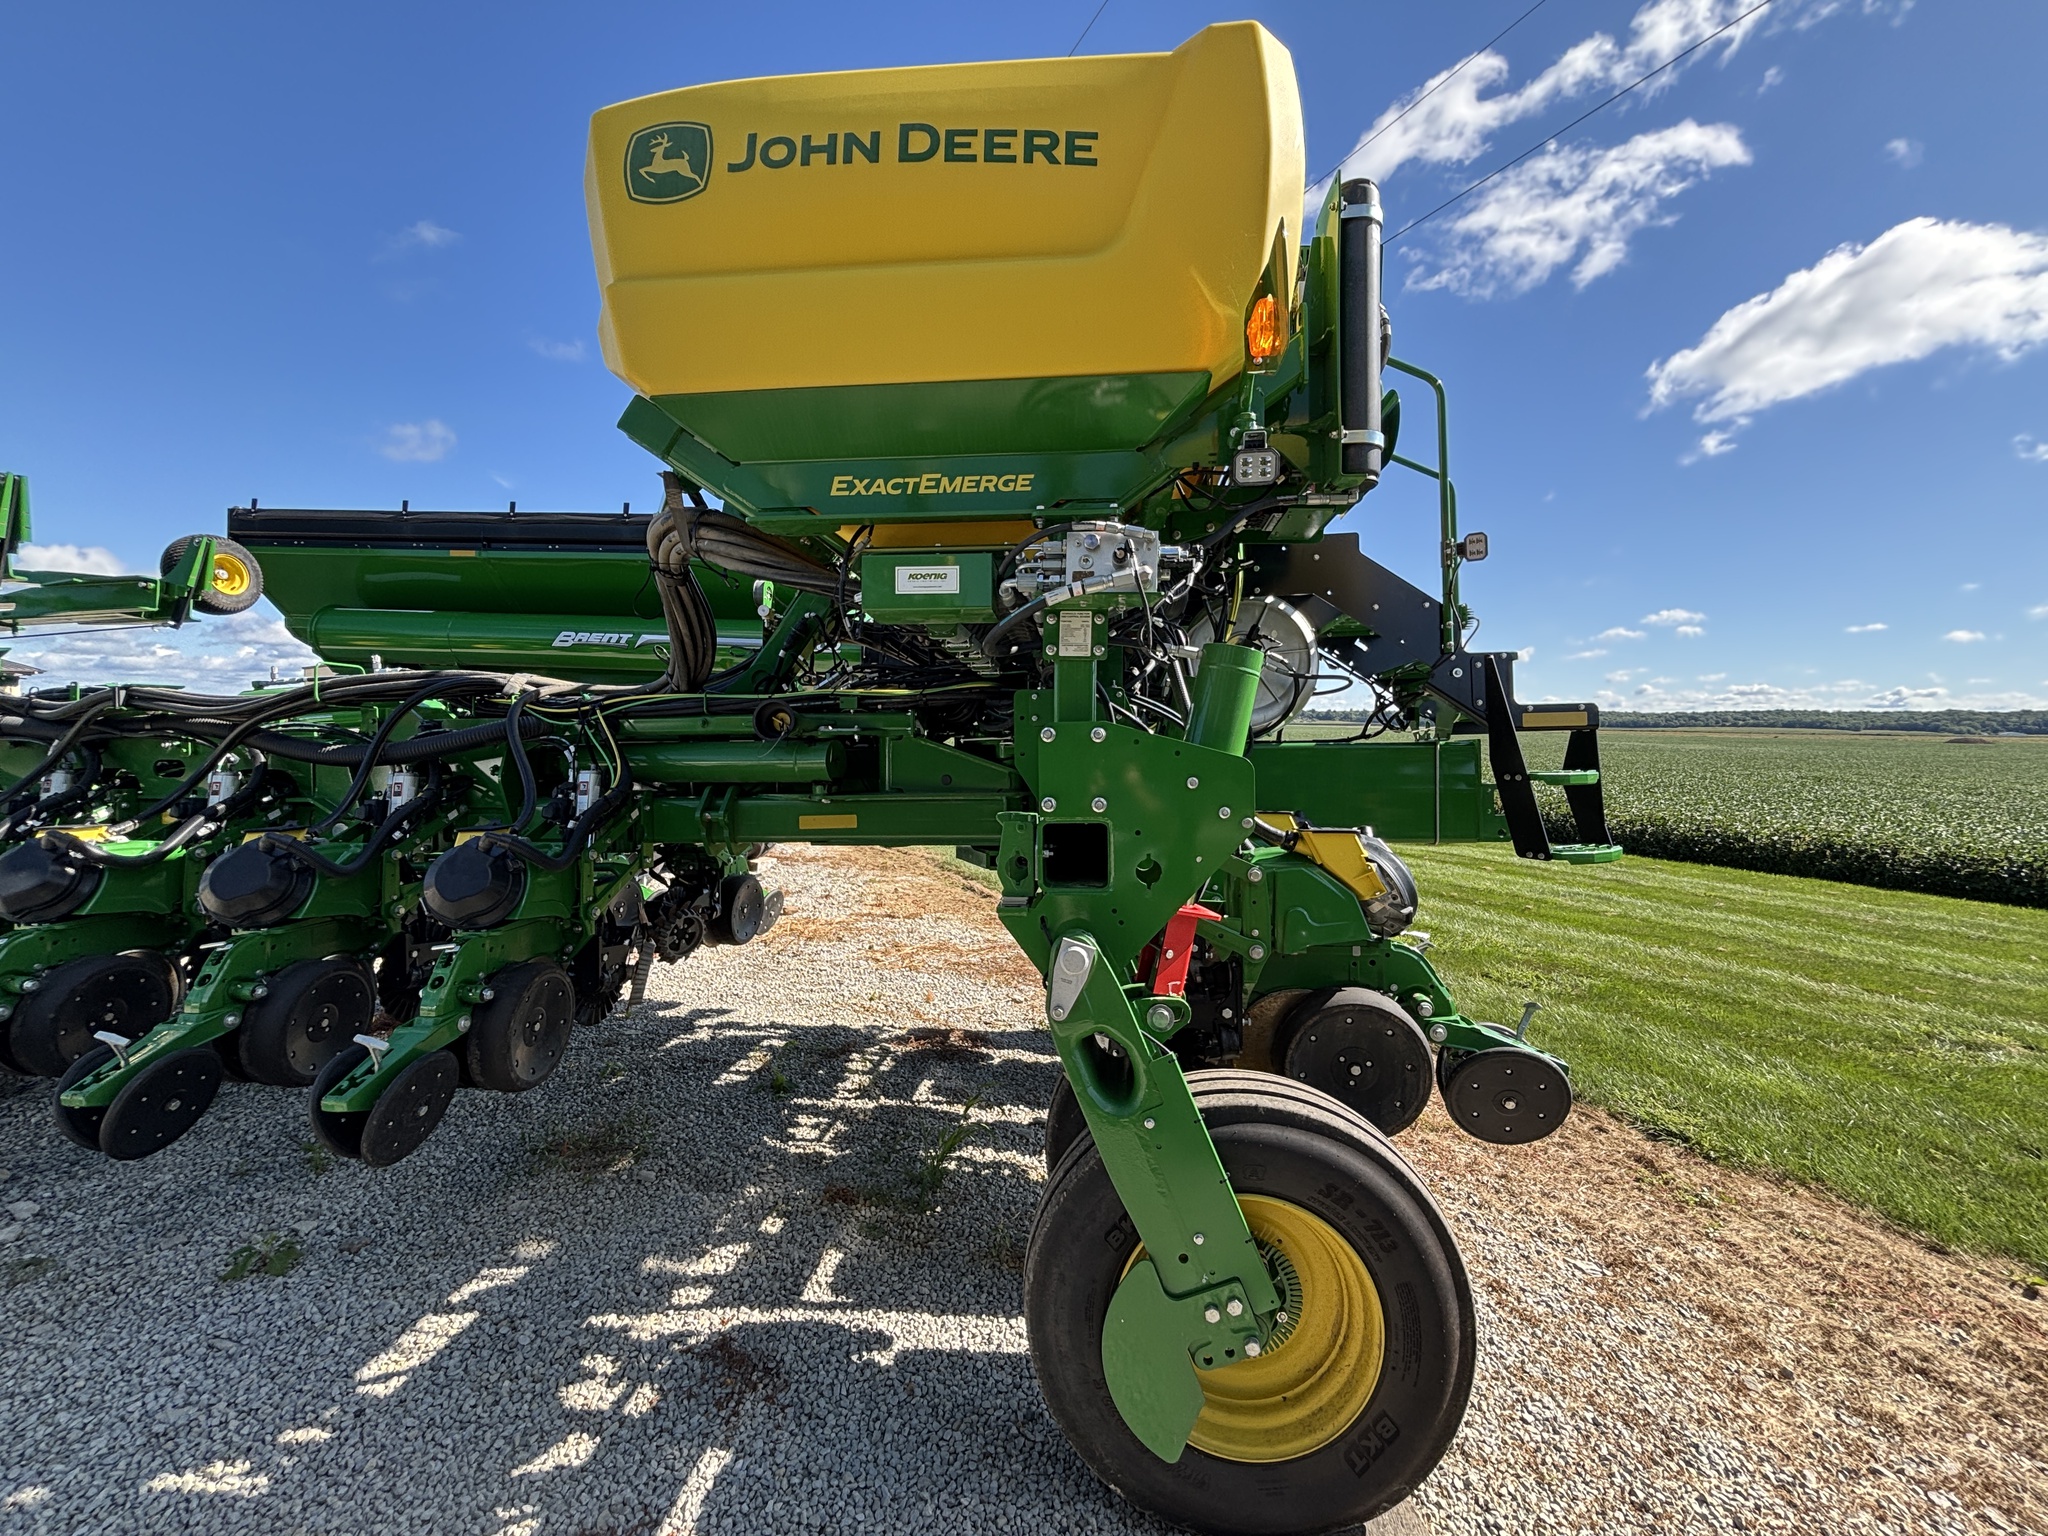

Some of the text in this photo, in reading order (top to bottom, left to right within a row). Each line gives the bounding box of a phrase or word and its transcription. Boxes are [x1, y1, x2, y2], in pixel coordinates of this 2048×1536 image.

[727, 123, 1099, 173] JOHN DEERE
[551, 631, 634, 647] BRENT
[1106, 1217, 1135, 1249] BK
[1347, 1411, 1396, 1475] BKT
